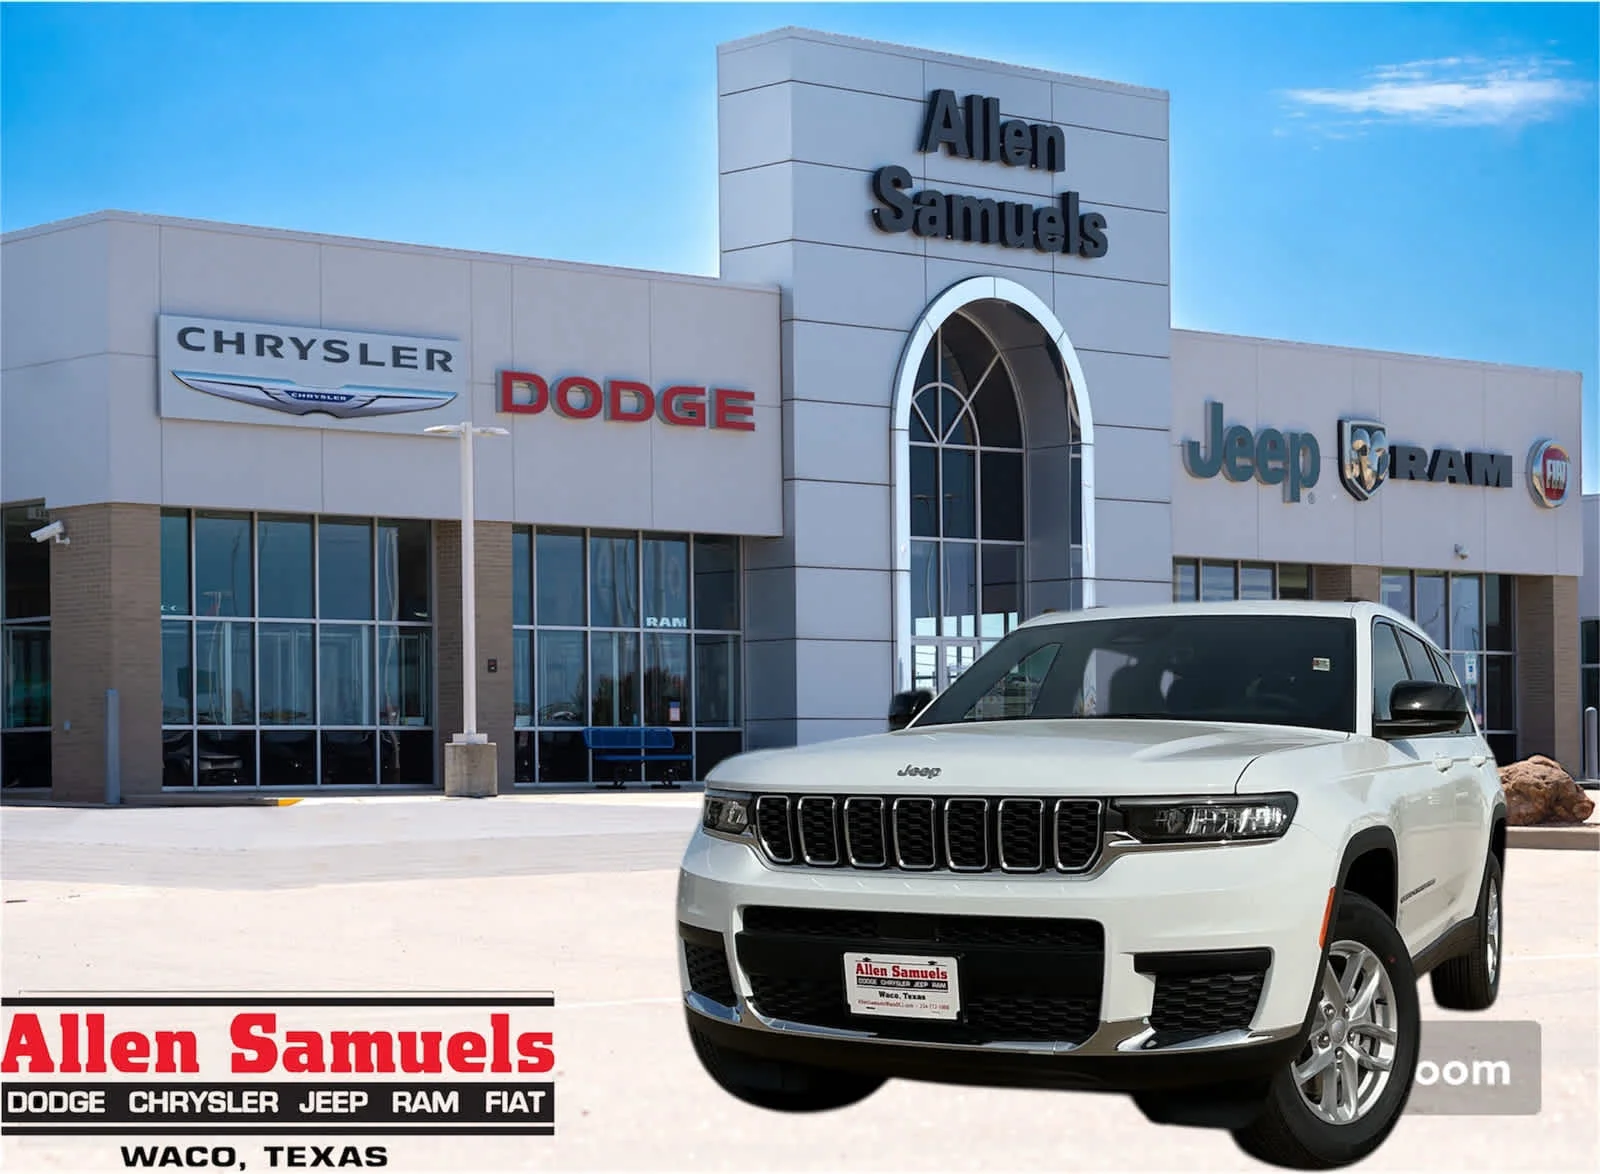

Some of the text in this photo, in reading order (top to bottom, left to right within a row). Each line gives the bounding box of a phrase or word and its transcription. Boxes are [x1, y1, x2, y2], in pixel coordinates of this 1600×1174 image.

[919, 88, 1066, 172] Allen
[871, 165, 1109, 258] Samuels
[177, 326, 455, 373] CHRYSLER
[291, 392, 347, 401] CHRYSLER
[496, 369, 756, 432] DODGE
[1183, 400, 1321, 503] Jeep
[1389, 444, 1513, 488] RAM
[645, 616, 688, 628] RAM
[896, 763, 942, 779] Jeep
[855, 963, 948, 980] Allen Samuels
[879, 991, 926, 1001] Waco, Texas
